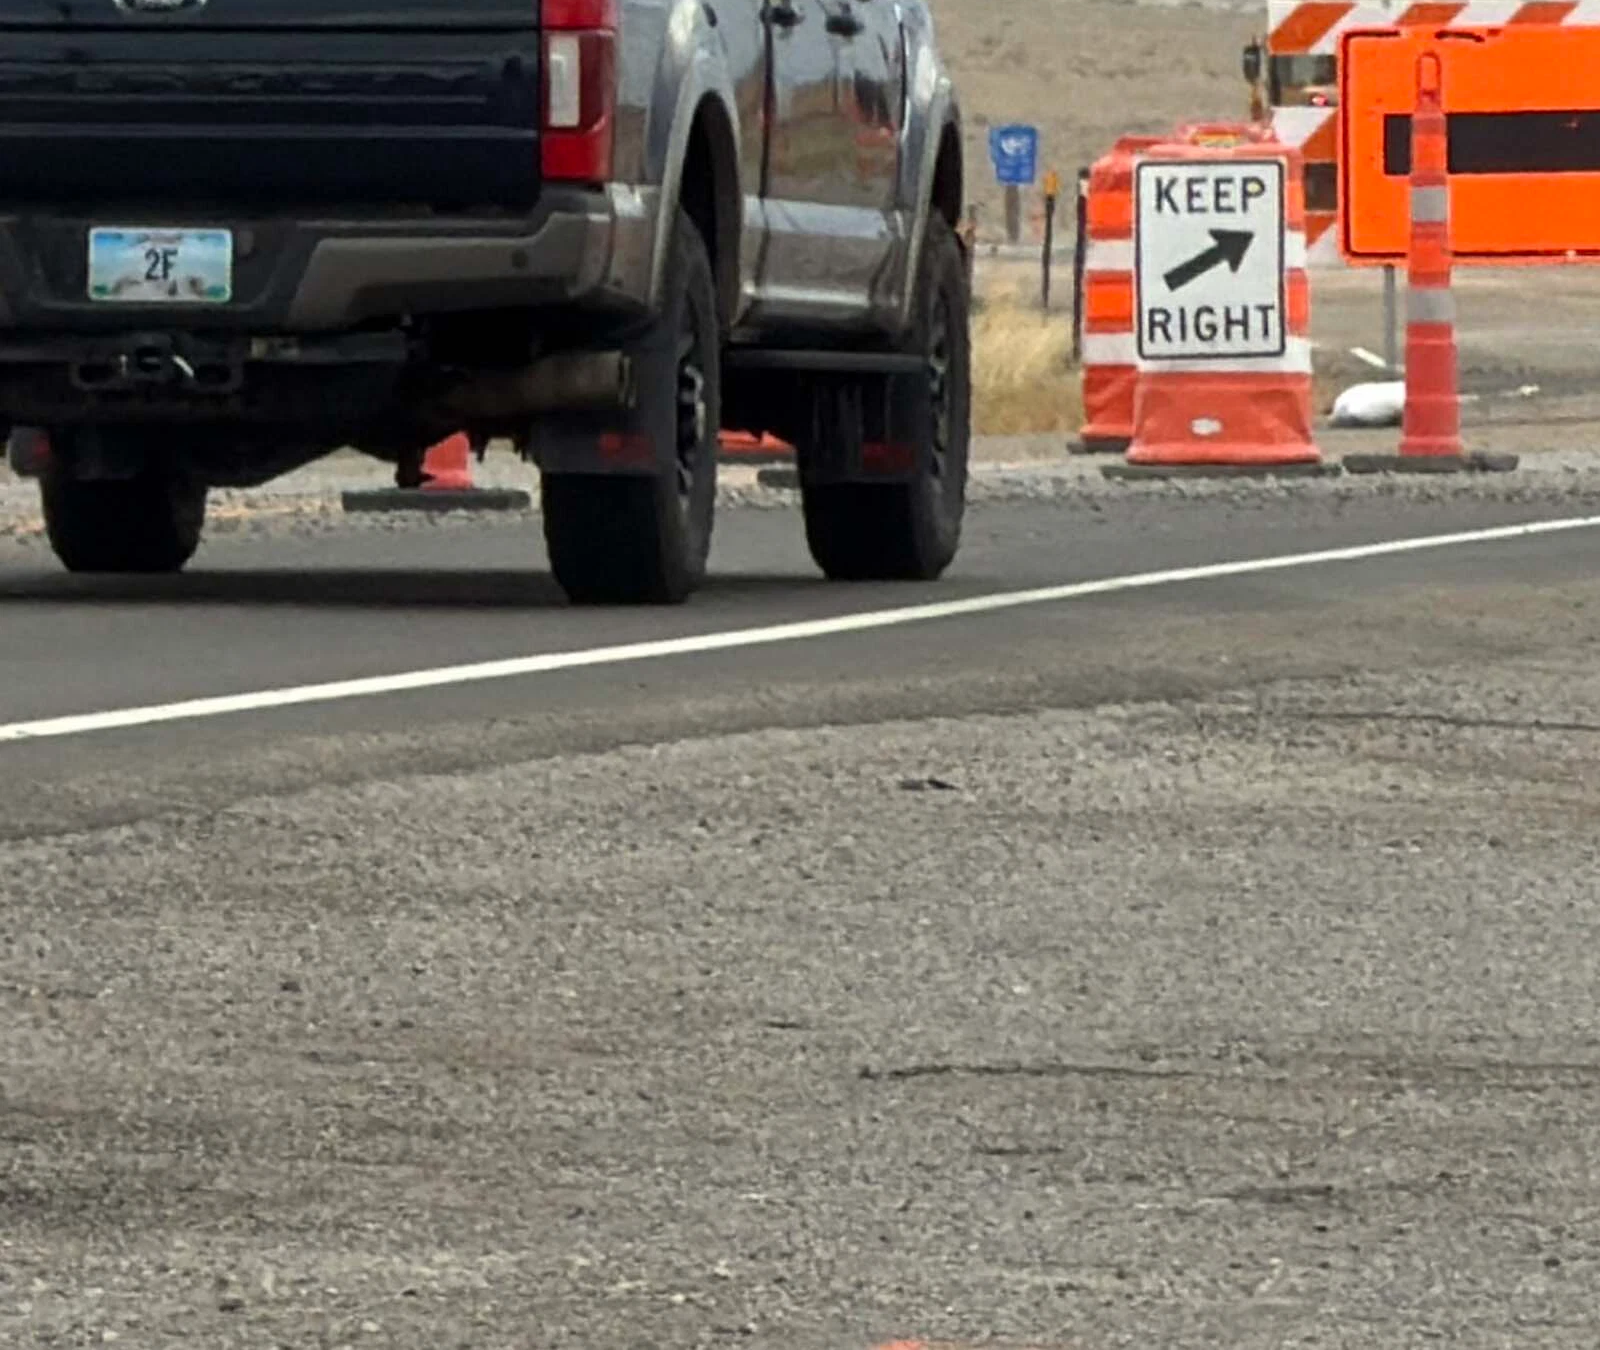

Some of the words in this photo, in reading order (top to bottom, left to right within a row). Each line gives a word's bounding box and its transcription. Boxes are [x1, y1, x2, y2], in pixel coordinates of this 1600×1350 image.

[1154, 175, 1266, 214] KEEP
[144, 247, 179, 280] 2F
[1147, 304, 1275, 342] RIGHT
